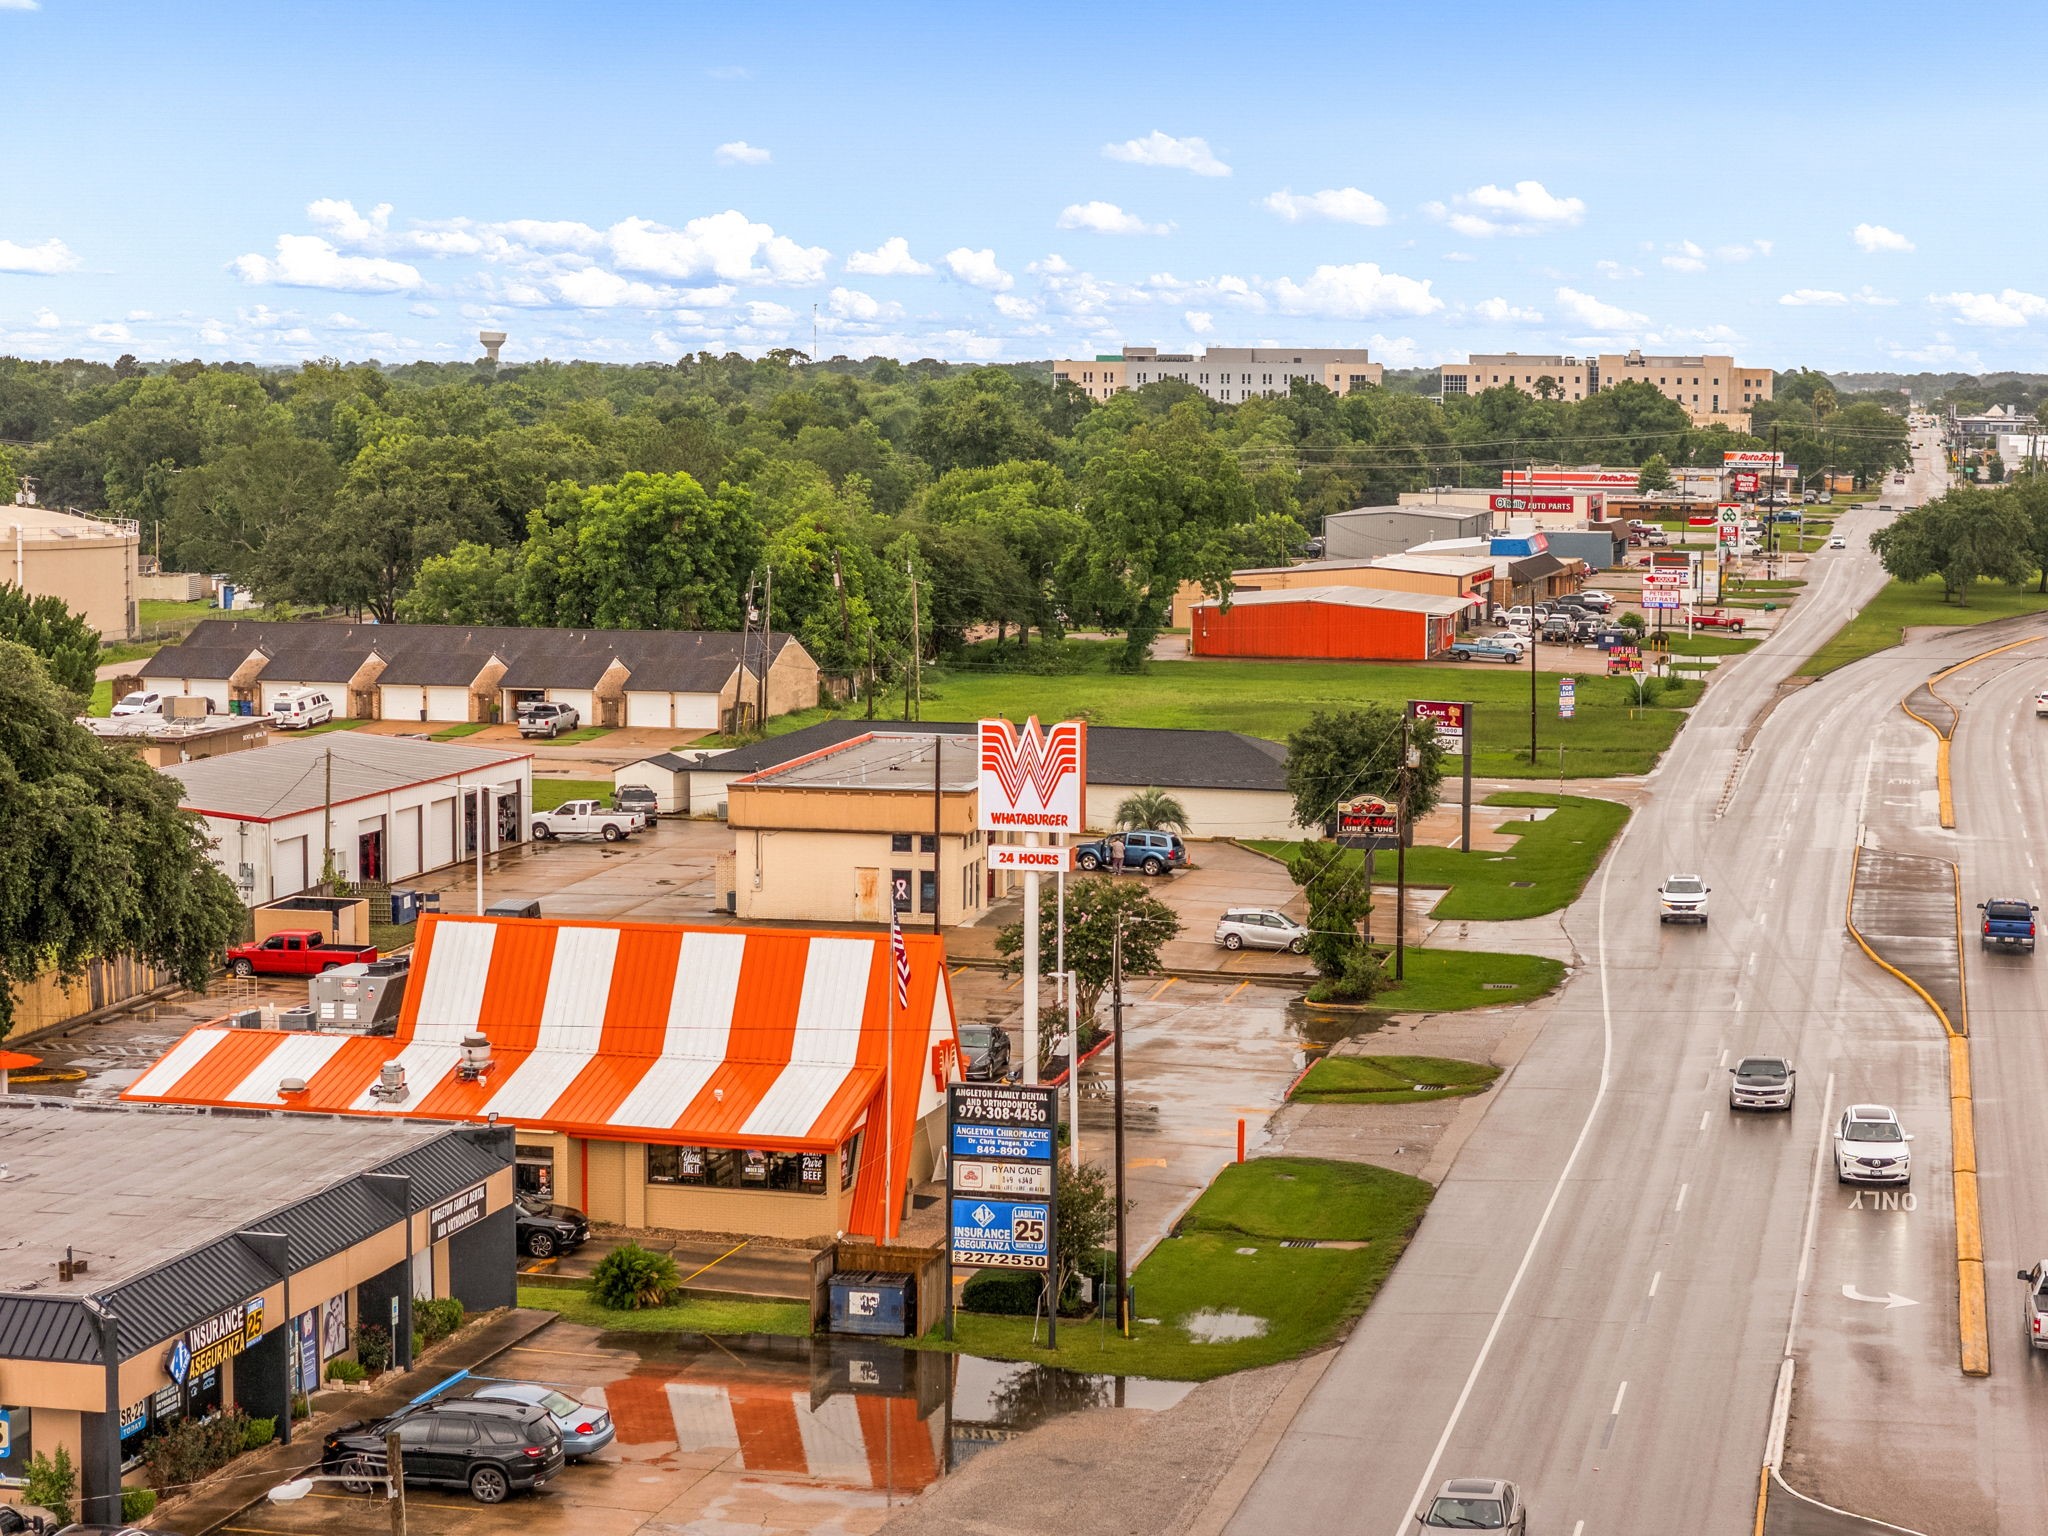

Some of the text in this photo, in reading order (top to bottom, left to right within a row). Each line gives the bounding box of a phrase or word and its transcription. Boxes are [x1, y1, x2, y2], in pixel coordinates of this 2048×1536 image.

[1496, 498, 1526, 510] O'Rilly
[1416, 704, 1446, 716] CLARK
[991, 812, 1068, 827] WHATABURGER
[999, 852, 1059, 865] 24 HOURS
[956, 1088, 1048, 1101] ANGLETON FAMILY DENTAL
[983, 1100, 1037, 1110] ORTHODONTICS
[959, 1105, 1046, 1122] 979-308-4450
[956, 1126, 1048, 1139] ANGLETON CHIROPRACTIC
[682, 1150, 700, 1162] You
[977, 1146, 1027, 1156] 849-8900
[683, 1162, 700, 1174] LIKE IT
[802, 1157, 822, 1169] Pure
[803, 1171, 822, 1181] BEEF
[992, 1166, 1042, 1175] RYAN CADE
[432, 1185, 485, 1224] ANGLETON FAMILY DENTAL
[1848, 1191, 1918, 1212] ONLY
[438, 1204, 479, 1238] AND ORTHODONTICS
[1014, 1210, 1044, 1219] LIABILITY
[954, 1226, 1010, 1239] INSURANCE
[954, 1240, 1010, 1251] ASEGURANZA
[964, 1252, 1045, 1266] 227-2550
[190, 1306, 244, 1352] INSURANCE
[247, 1310, 262, 1339] 25
[189, 1332, 245, 1380] ASEGURANZA
[121, 1400, 144, 1426] SR-22
[124, 1421, 142, 1436] TODAY
